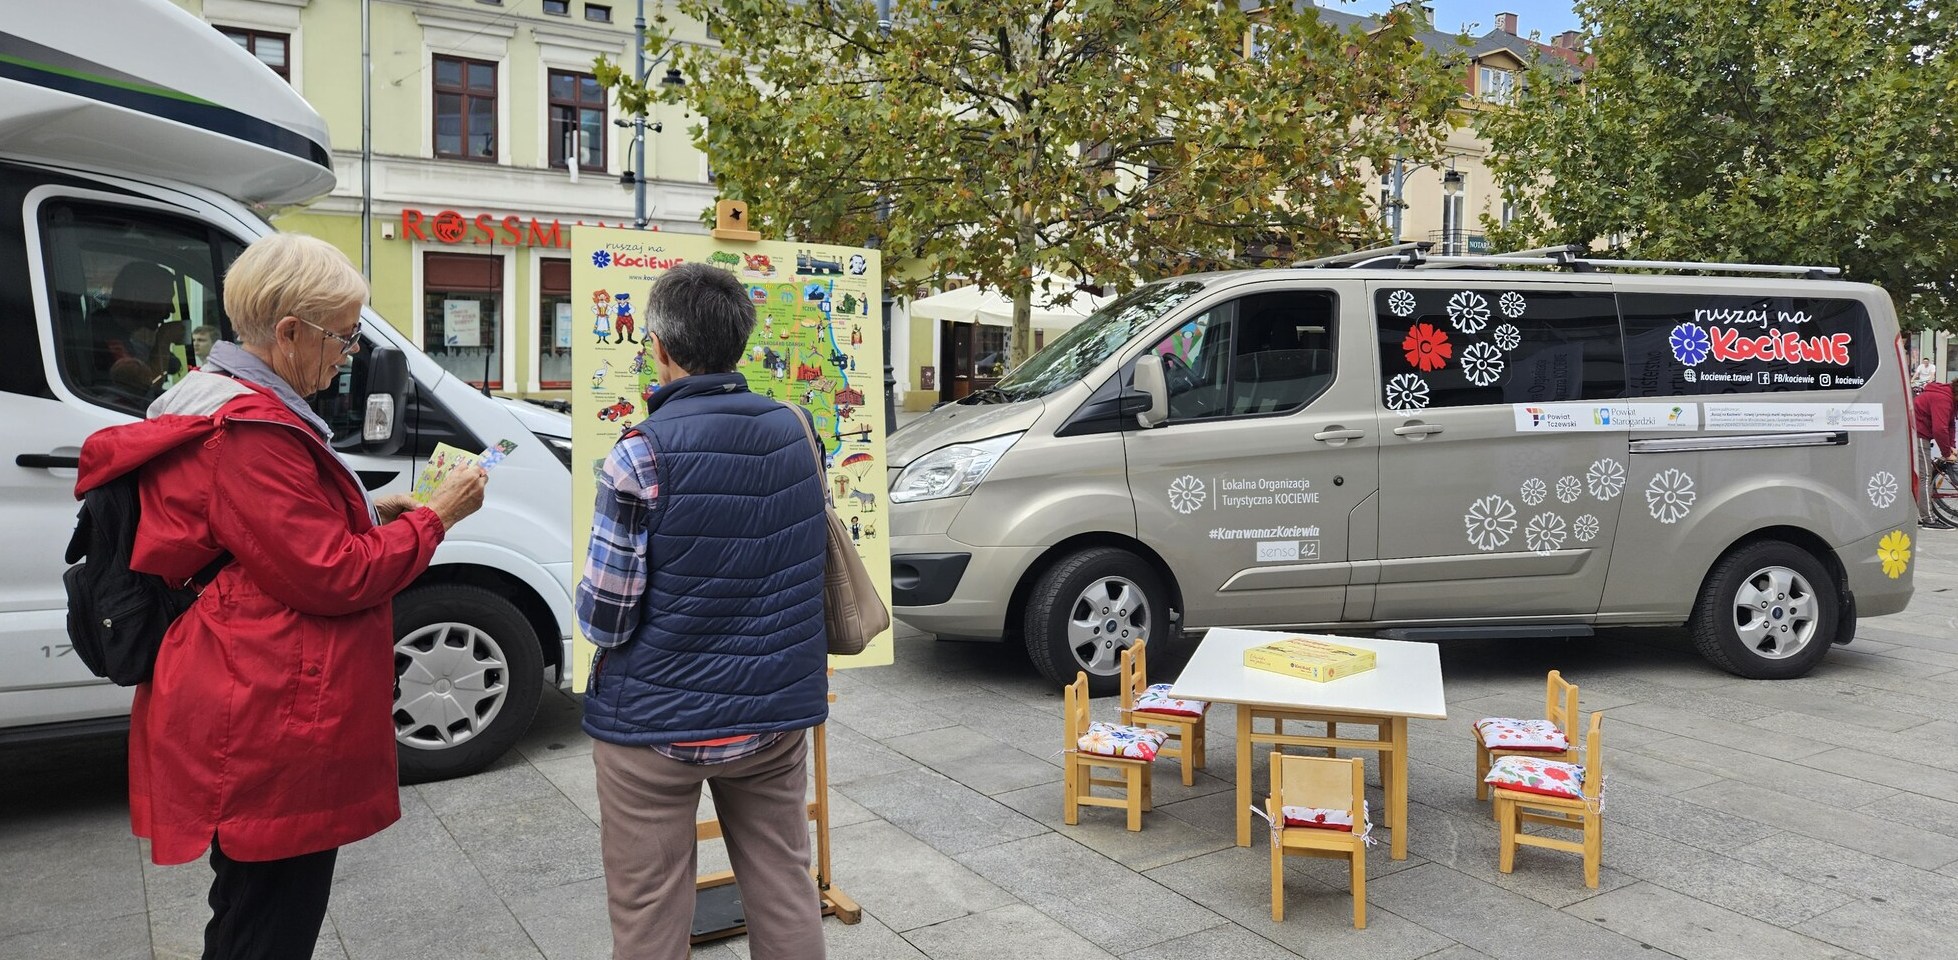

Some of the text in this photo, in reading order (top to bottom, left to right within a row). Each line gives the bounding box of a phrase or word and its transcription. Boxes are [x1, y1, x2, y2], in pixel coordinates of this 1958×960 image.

[402, 209, 660, 249] ROSSM
[605, 242, 665, 254] ruszaj na
[1694, 304, 1813, 329] ruszaj na
[1700, 372, 1865, 385] kociewie.travel FB/kociewie kociewie
[1611, 408, 1636, 416] Powiat
[1547, 420, 1577, 428] Tczewski
[1612, 417, 1656, 427] Starogardzki
[1222, 478, 1310, 492] Lokalna Organizacja
[1222, 493, 1320, 508] Turystyczna KOCIEWIE
[1209, 525, 1320, 540] #KarawanazKociewia
[1260, 543, 1317, 559] senso 42
